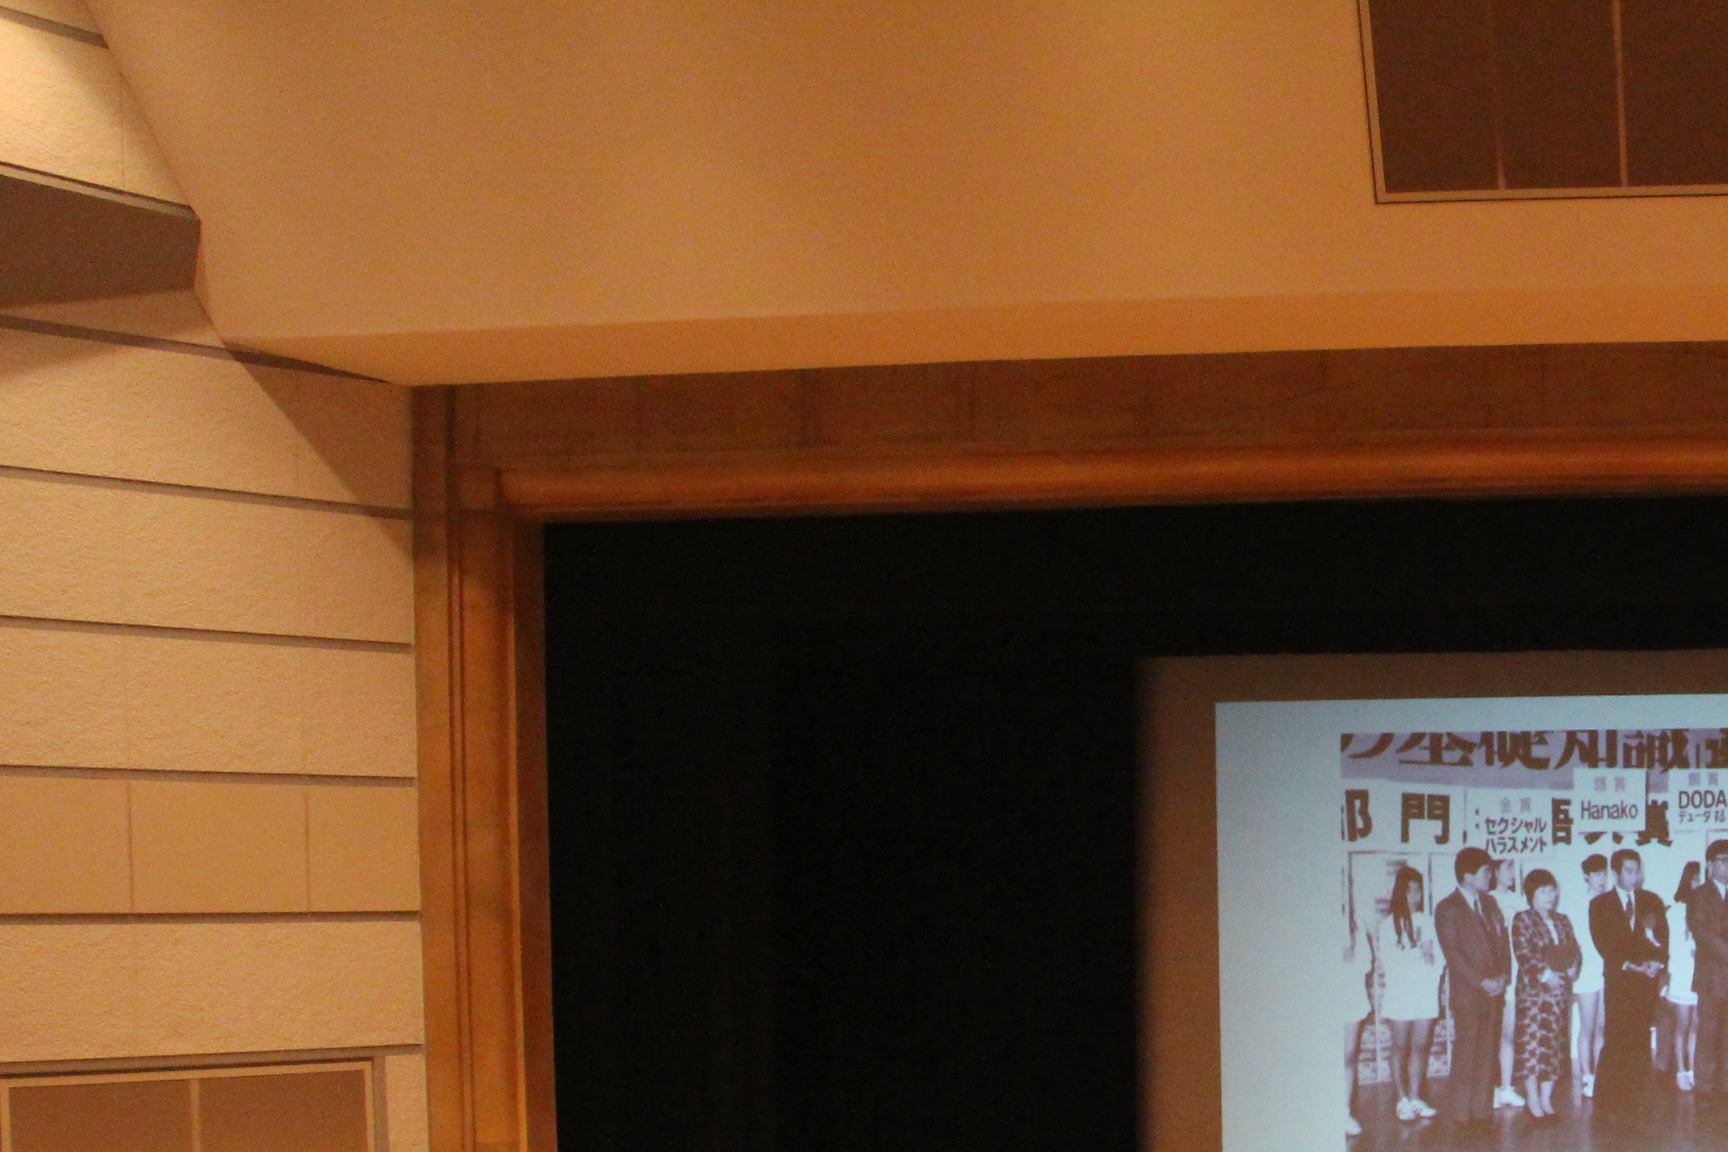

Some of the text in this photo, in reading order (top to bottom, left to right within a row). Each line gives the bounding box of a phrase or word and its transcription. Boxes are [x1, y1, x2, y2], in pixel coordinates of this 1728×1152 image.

[1678, 789, 1728, 809] DODA
[1580, 800, 1639, 820] Hanako
[1485, 817, 1548, 835] セクシャル
[1485, 836, 1548, 854] ハラスメント
